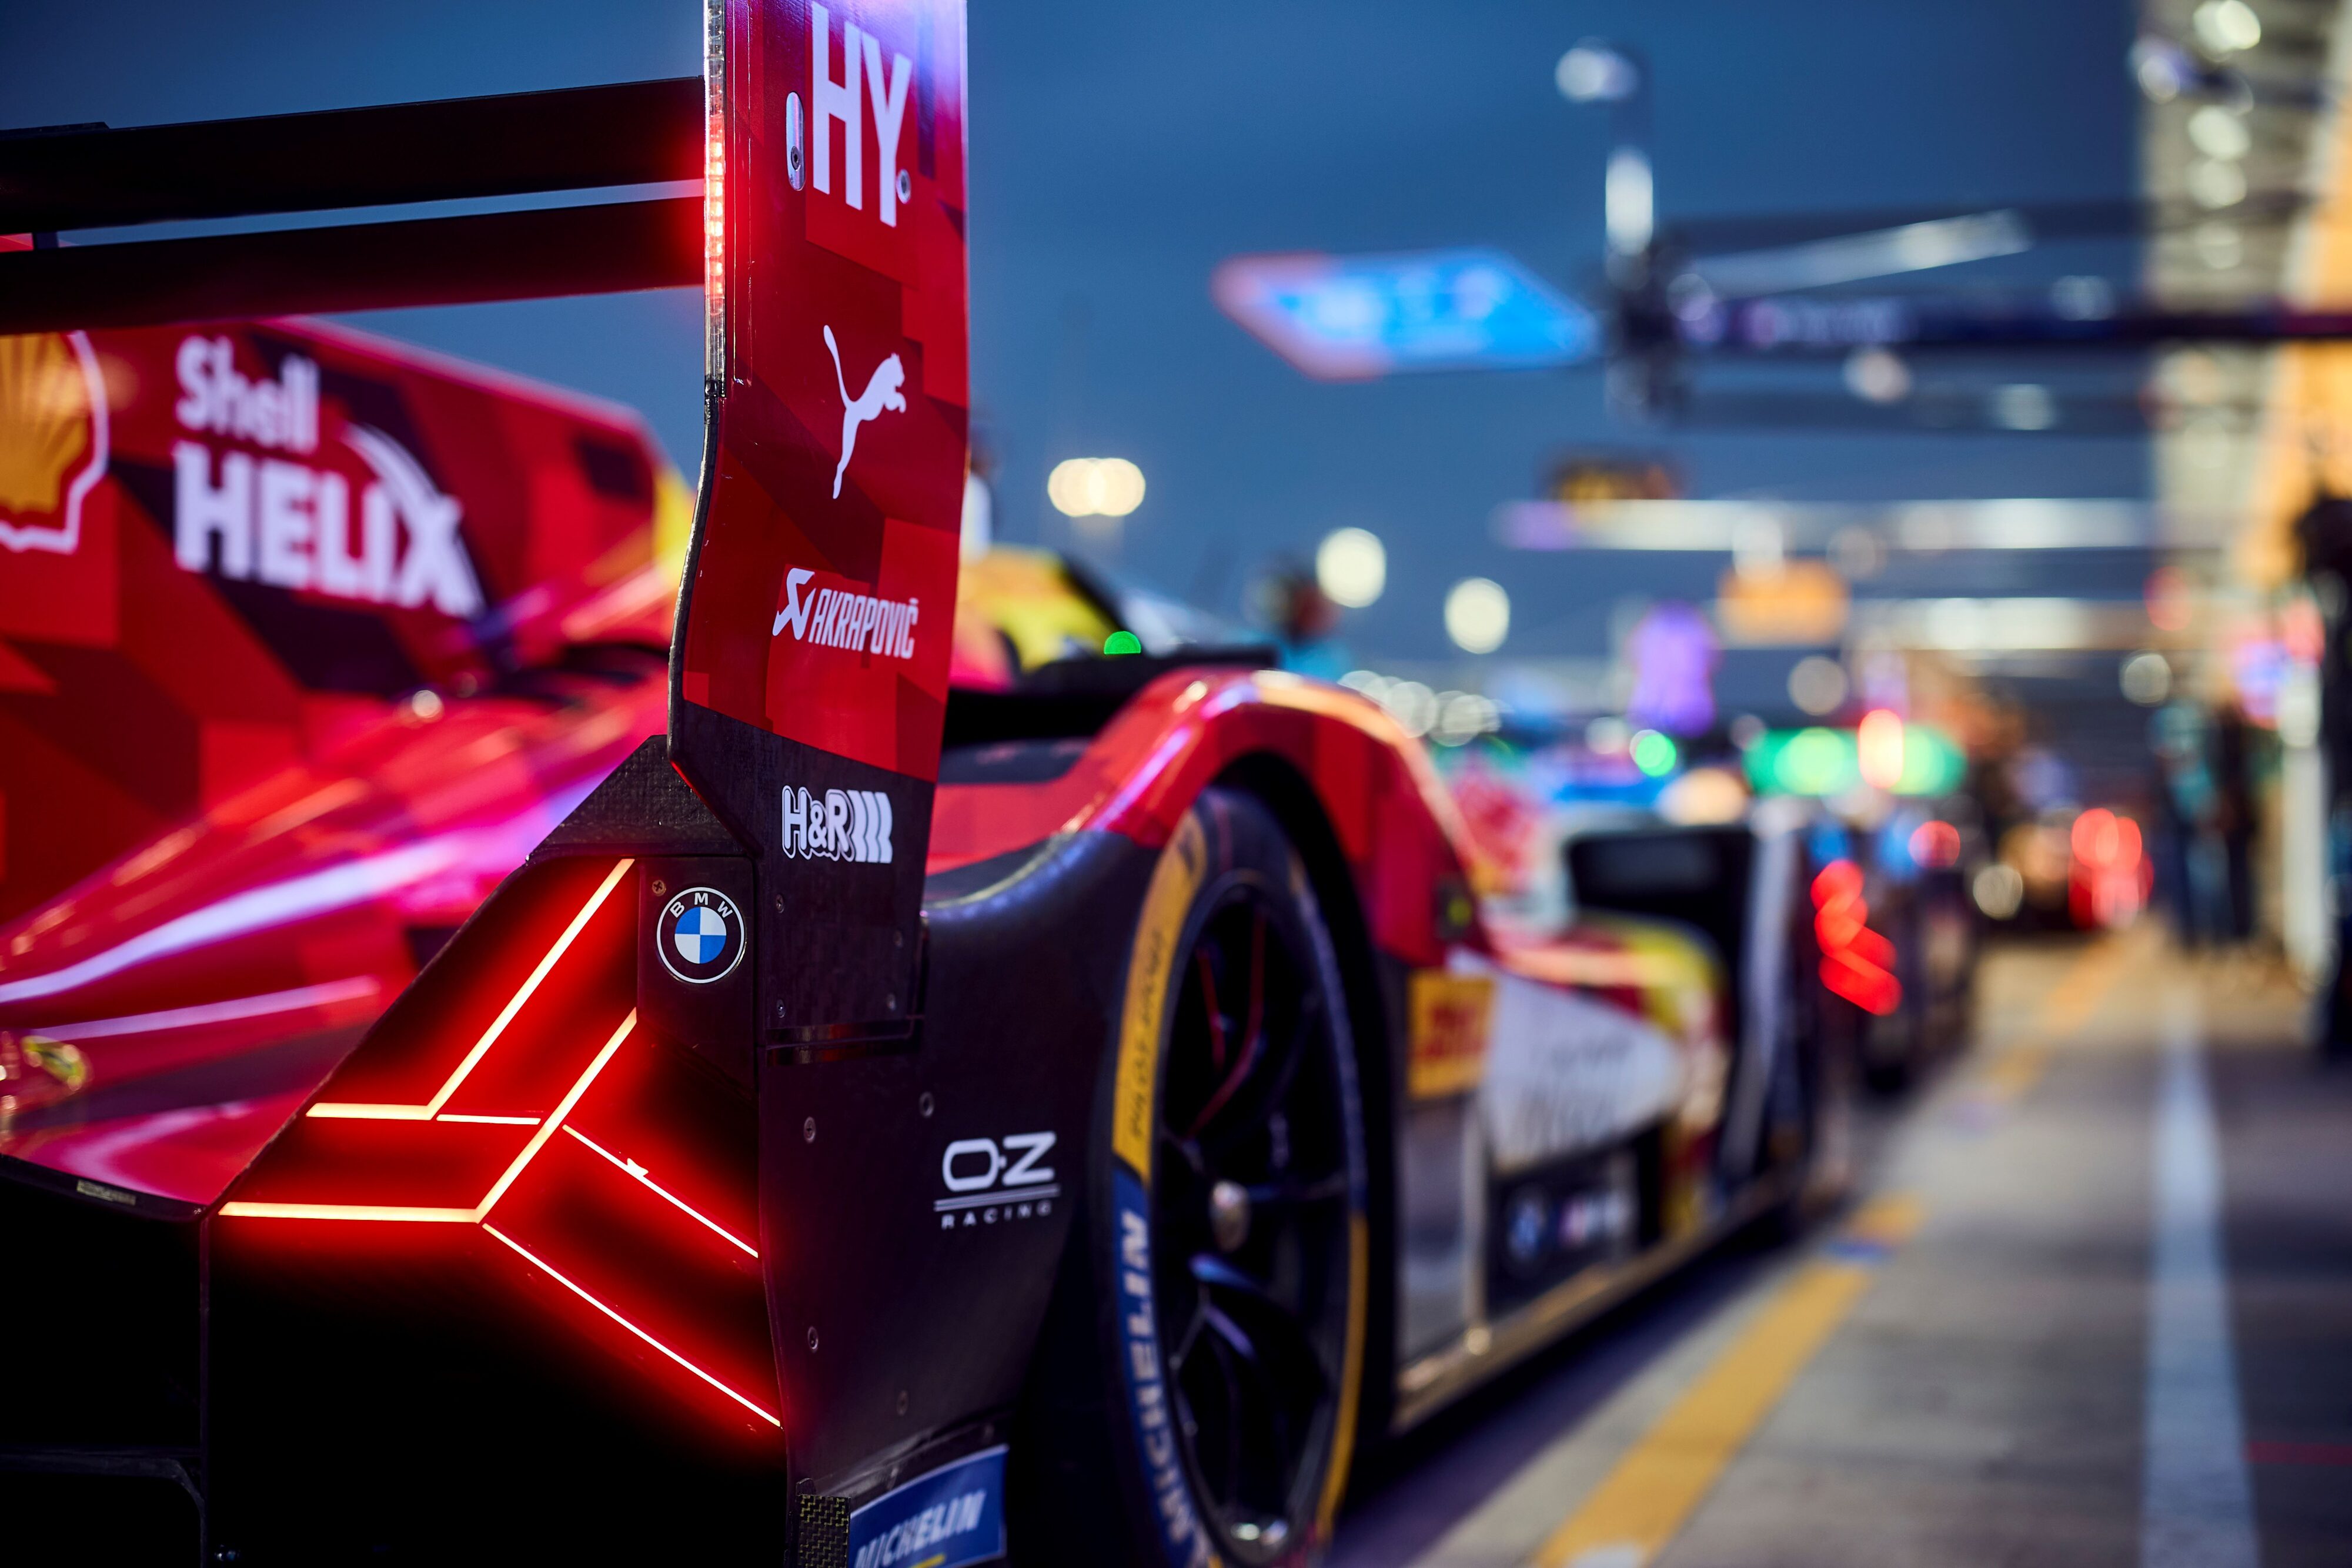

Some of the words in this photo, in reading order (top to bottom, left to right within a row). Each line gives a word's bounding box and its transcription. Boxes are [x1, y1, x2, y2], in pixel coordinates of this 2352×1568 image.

[812, 2, 912, 228] HY
[175, 335, 320, 455] Shell
[173, 439, 483, 620] HELIX
[808, 588, 918, 660] AKRAPOVIČ
[781, 784, 856, 862] H&R
[670, 892, 733, 918] BMW
[941, 1201, 1051, 1229] RACING
[1121, 1208, 1192, 1544] MICHELIN
